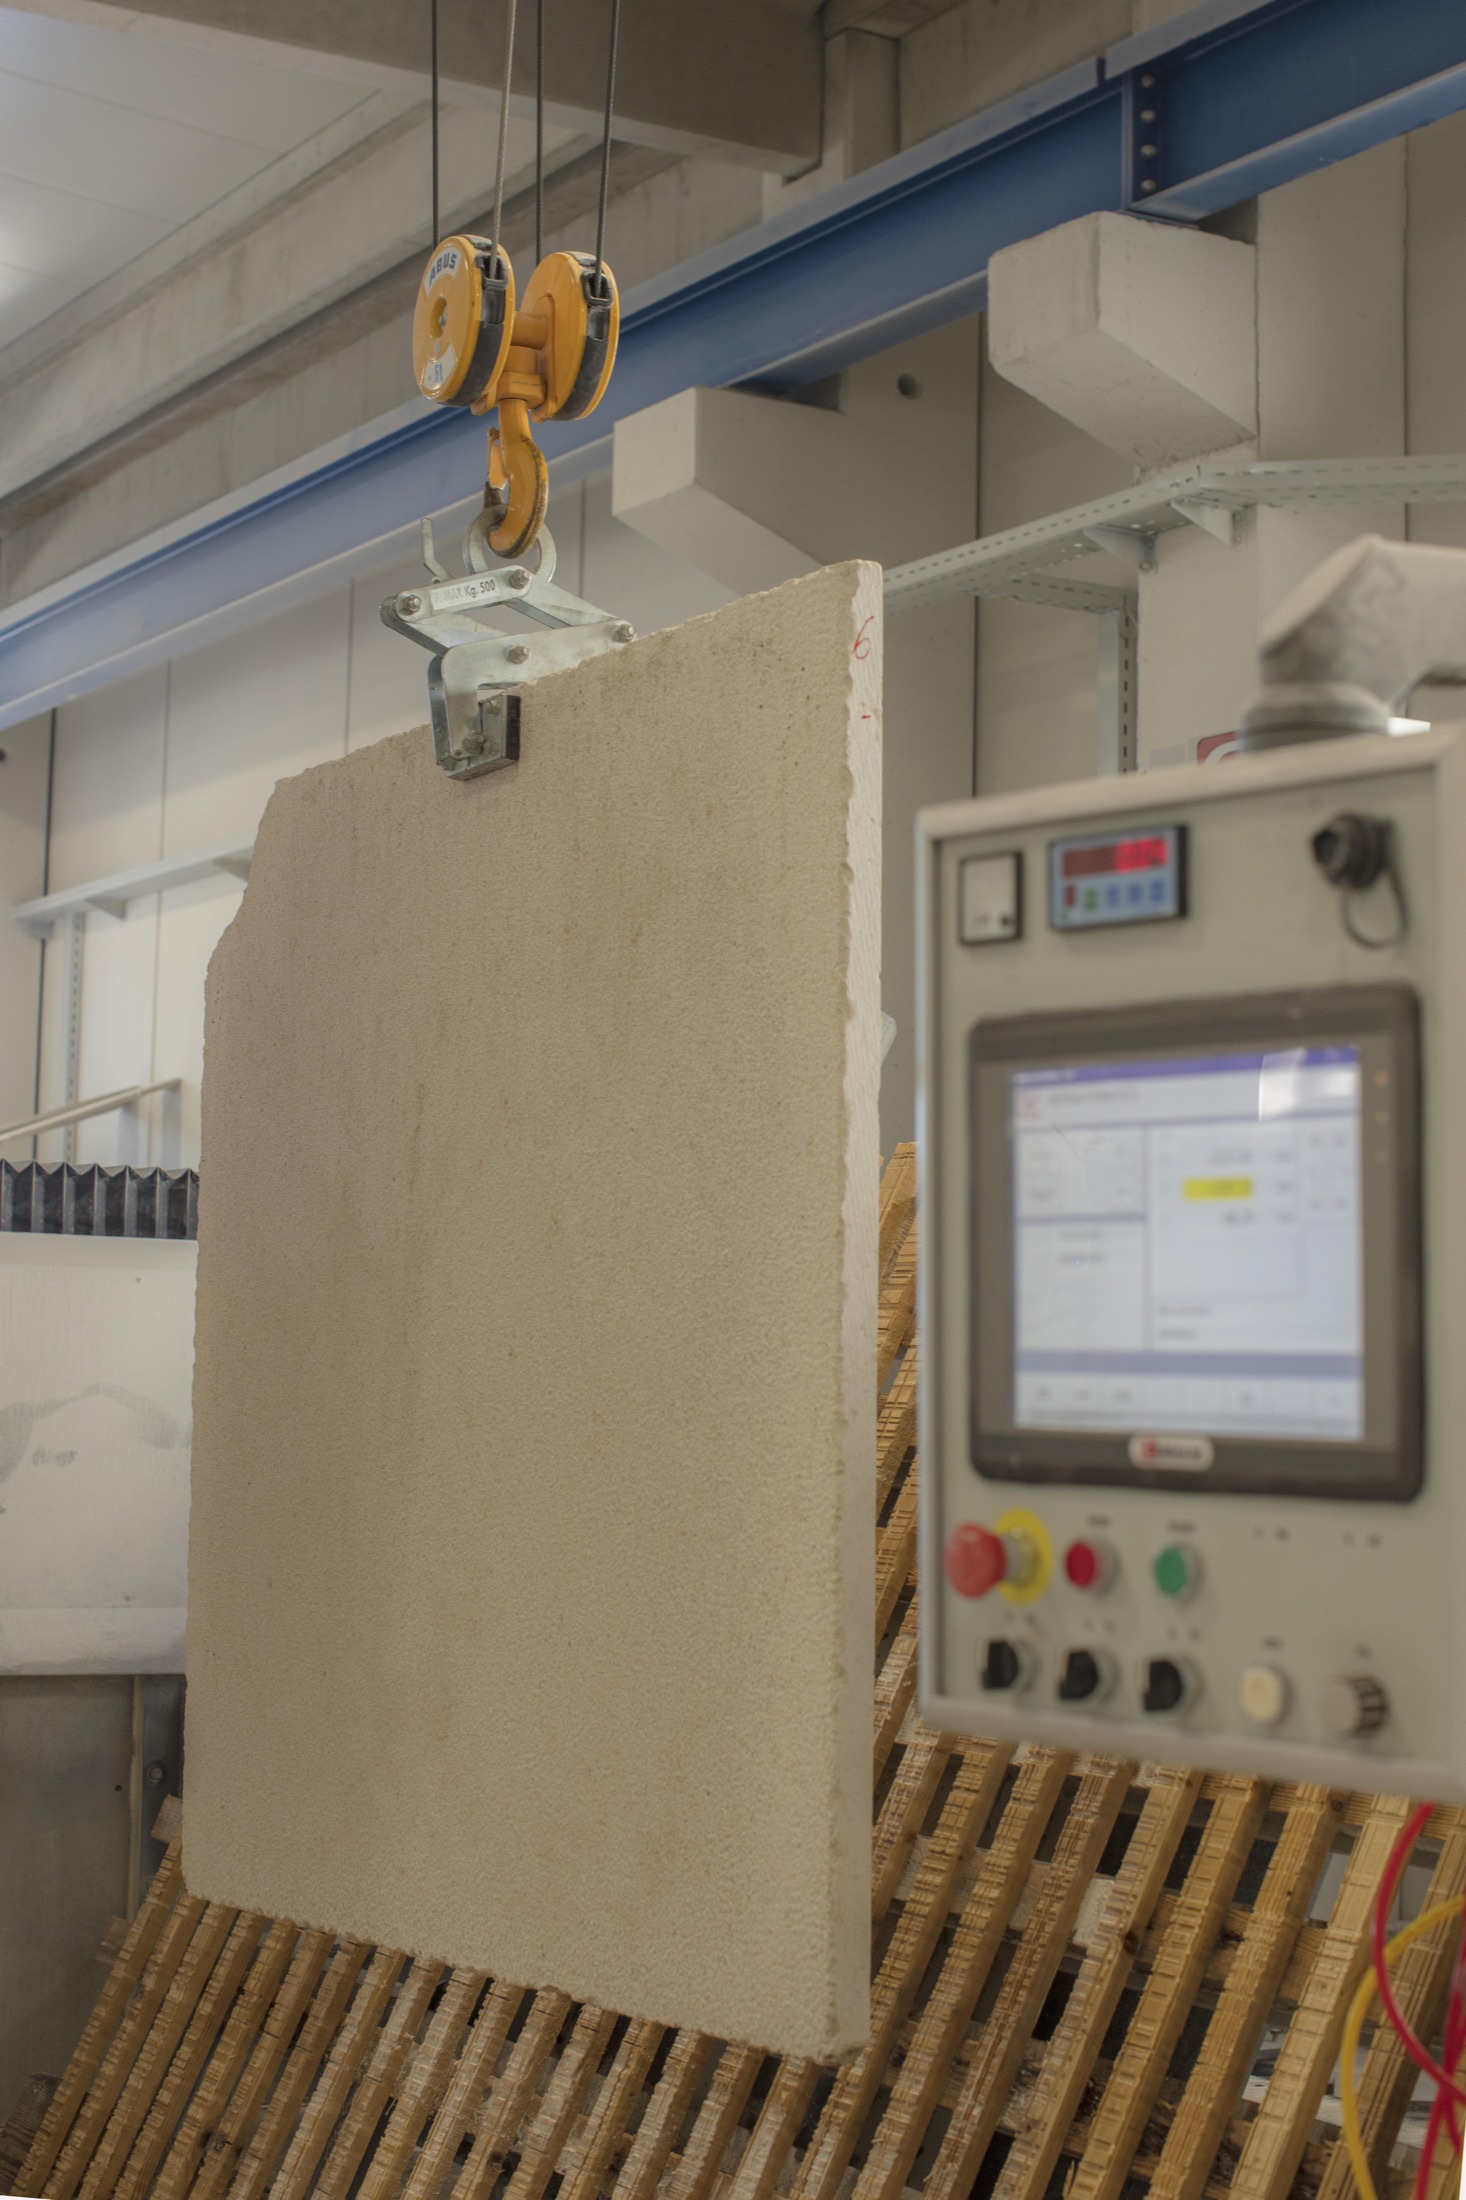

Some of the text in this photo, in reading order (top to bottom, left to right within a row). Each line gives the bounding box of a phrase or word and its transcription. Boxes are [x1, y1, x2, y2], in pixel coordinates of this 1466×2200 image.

[429, 252, 457, 286] ABUS
[444, 586, 463, 600] MAX
[464, 584, 479, 598] Kg.
[480, 579, 496, 593] 500
[853, 615, 875, 660] 6
